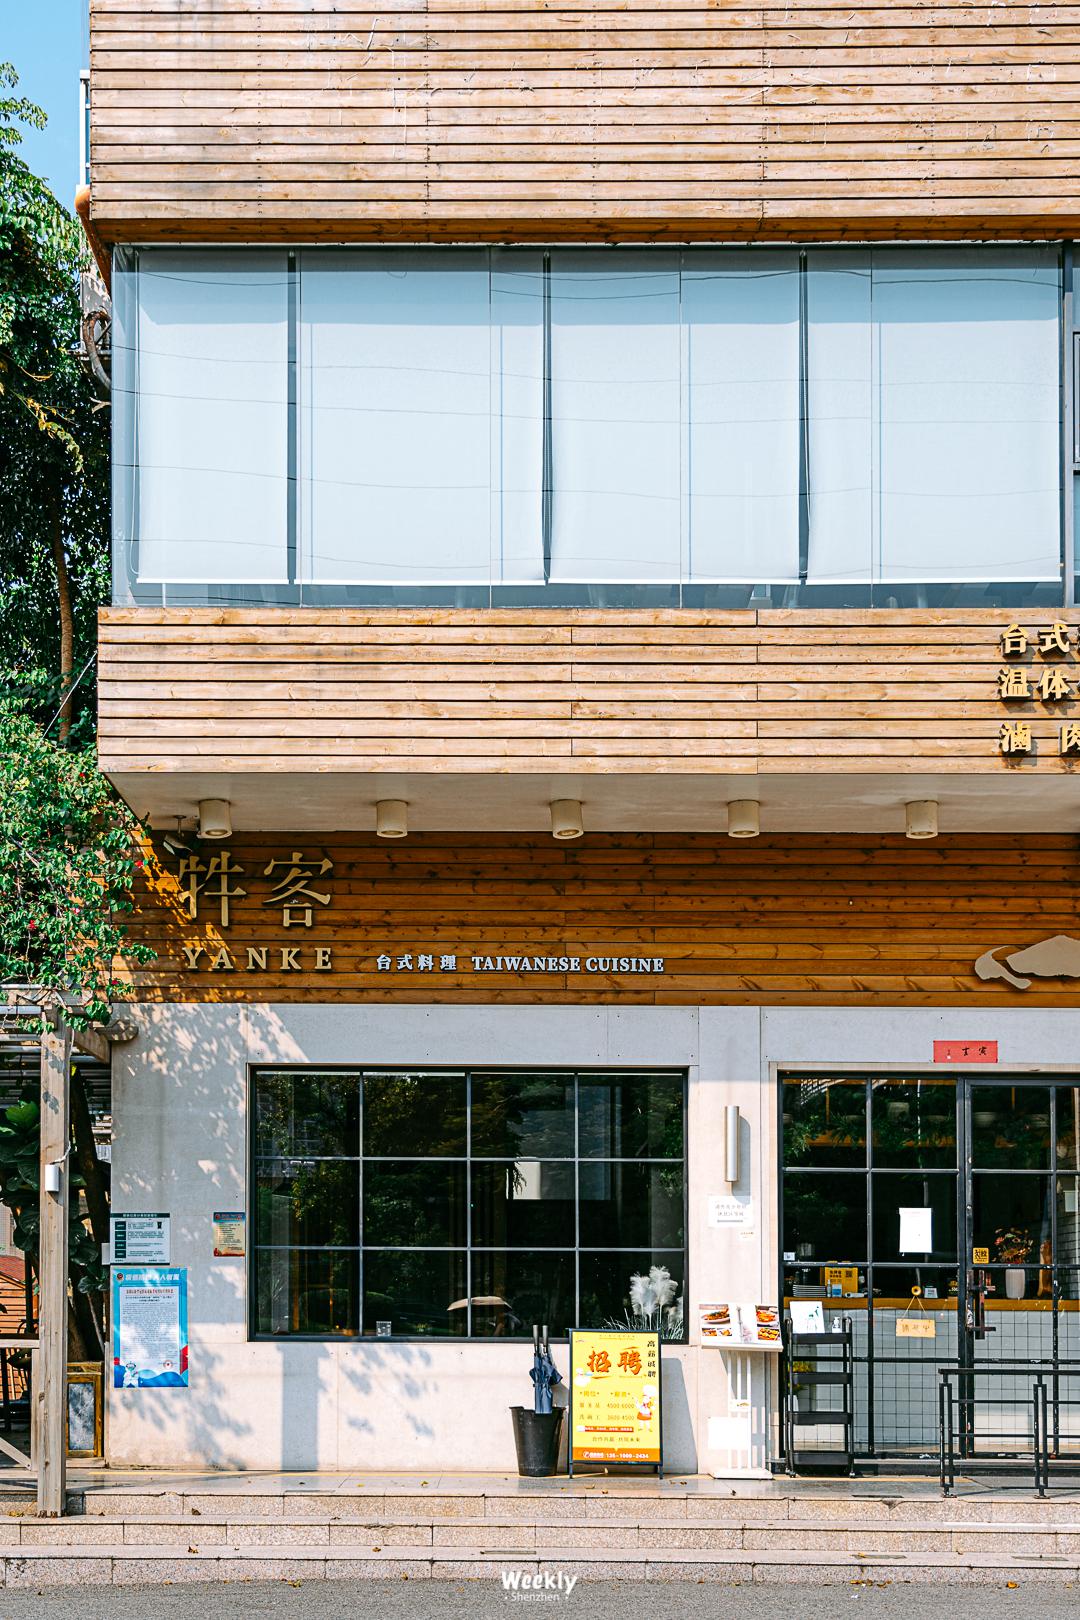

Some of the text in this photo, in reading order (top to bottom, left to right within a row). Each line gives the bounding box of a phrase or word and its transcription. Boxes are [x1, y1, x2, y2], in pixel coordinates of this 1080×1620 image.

[1002, 623, 1070, 654] 台式
[182, 947, 332, 970] YANKE
[376, 954, 457, 971] 台式料理
[472, 956, 664, 973] TAIWANESE CUISINE
[587, 1349, 643, 1376] 招聘
